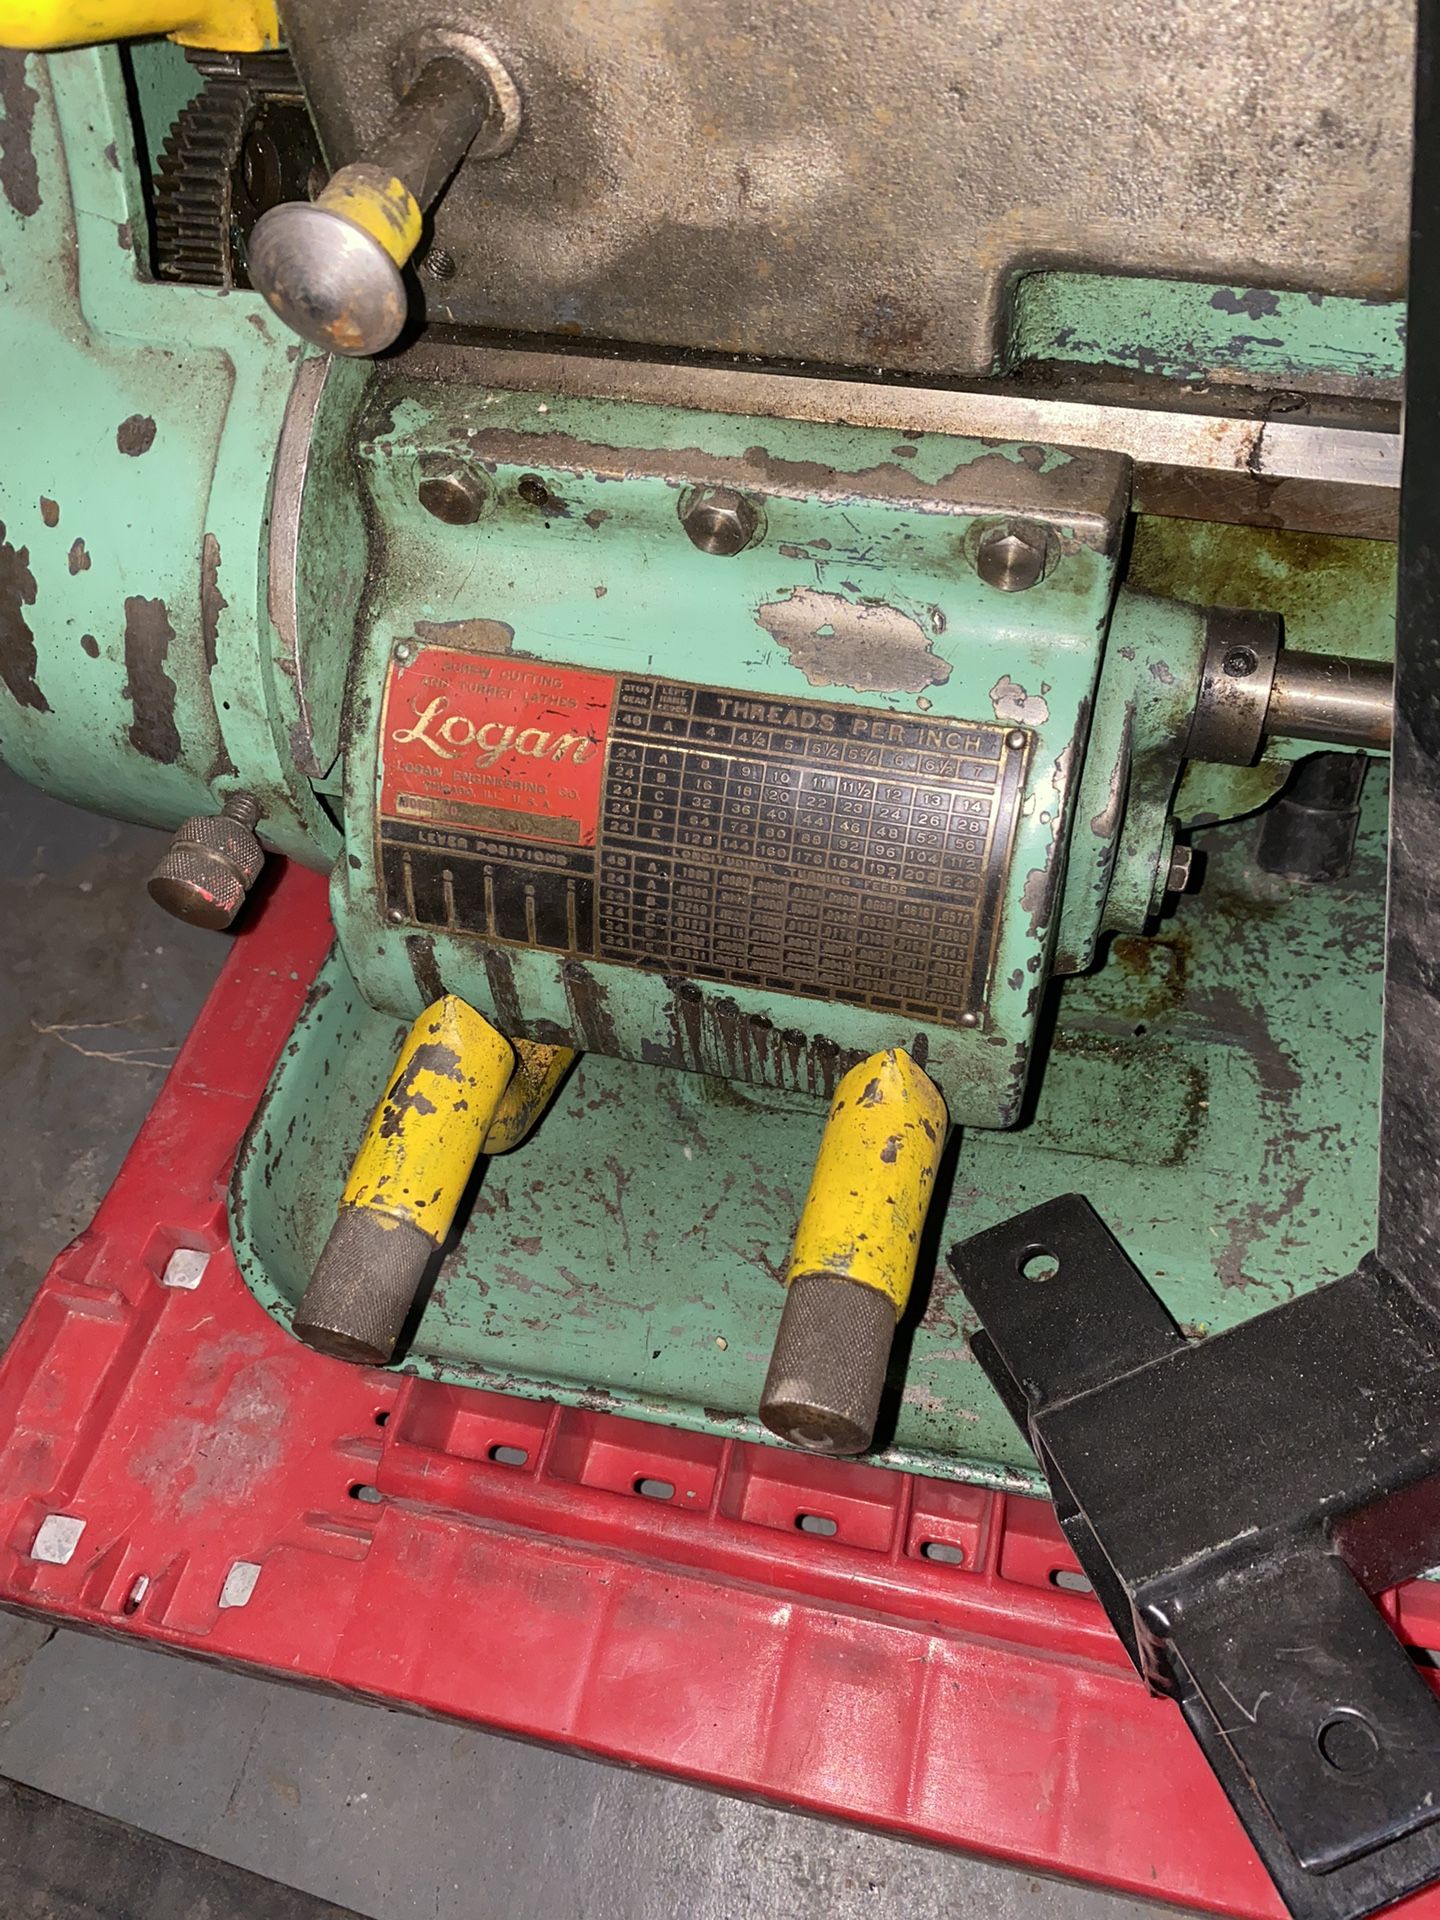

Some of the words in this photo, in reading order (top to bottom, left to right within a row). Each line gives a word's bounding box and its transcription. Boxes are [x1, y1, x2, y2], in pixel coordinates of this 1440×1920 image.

[422, 677, 449, 688] AND
[460, 681, 514, 699] TURRET
[524, 691, 577, 708] LATHES
[502, 669, 563, 688] CUTTING
[392, 695, 598, 769] Logan
[622, 713, 641, 726] 48
[664, 719, 672, 731] A
[706, 726, 715, 737] 4
[784, 738, 793, 749] 5
[894, 755, 903, 766] 6
[972, 767, 981, 778] 7
[716, 698, 834, 731] THREADS
[852, 718, 905, 742] PER
[918, 728, 982, 753] INCH
[397, 760, 442, 777] LOGAN
[453, 769, 546, 794] ENGINEERING
[617, 747, 636, 759] 24
[659, 753, 668, 764] A
[700, 760, 709, 770] 8
[741, 766, 750, 777] 9
[773, 771, 789, 783] 10
[812, 777, 825, 789] 11
[885, 789, 901, 801] 12
[923, 795, 940, 807] 13
[962, 801, 981, 813] 14
[613, 784, 632, 796] 24
[654, 790, 664, 800] C
[692, 796, 711, 808] 32
[731, 803, 750, 814] 36
[766, 808, 786, 820] 40
[802, 814, 823, 826] 44
[840, 820, 860, 832] 46
[876, 826, 898, 838] 48
[916, 832, 936, 845] 52
[954, 839, 974, 851] 56
[615, 765, 634, 777] 24
[656, 772, 666, 782] B
[696, 778, 711, 790] 16
[736, 785, 751, 796] 18
[769, 790, 788, 802] 20
[807, 796, 826, 808] 22
[843, 802, 862, 814] 23
[879, 807, 901, 820] 24
[918, 814, 939, 826] 26
[957, 820, 978, 832] 28
[419, 831, 468, 848] LEVER
[477, 841, 568, 866] POSITIONS
[609, 820, 629, 832] 24
[651, 827, 660, 837] E
[684, 832, 712, 845] 128
[722, 839, 749, 851] 144
[760, 845, 785, 858] 160
[796, 851, 822, 864] 176
[831, 857, 858, 870] 184
[870, 863, 896, 876] 192
[904, 869, 936, 882] 208
[943, 875, 977, 889] 224
[611, 802, 630, 814] 24
[653, 809, 662, 819] D
[689, 815, 710, 827] 64
[731, 822, 748, 833] 72
[765, 827, 785, 839] 80
[801, 833, 821, 845] 88
[838, 839, 858, 851] 92
[875, 845, 895, 857] 96
[909, 851, 937, 864] 104
[950, 857, 976, 870] 112
[606, 854, 626, 867] 48
[647, 861, 656, 872] A
[606, 872, 624, 884] 24
[647, 879, 656, 890] A
[672, 848, 775, 872] LONGITUDINAL
[788, 867, 850, 885] TURNING
[864, 880, 906, 894] FEEDS
[605, 905, 624, 916] 24
[605, 921, 624, 932] 24
[605, 934, 624, 945] 24
